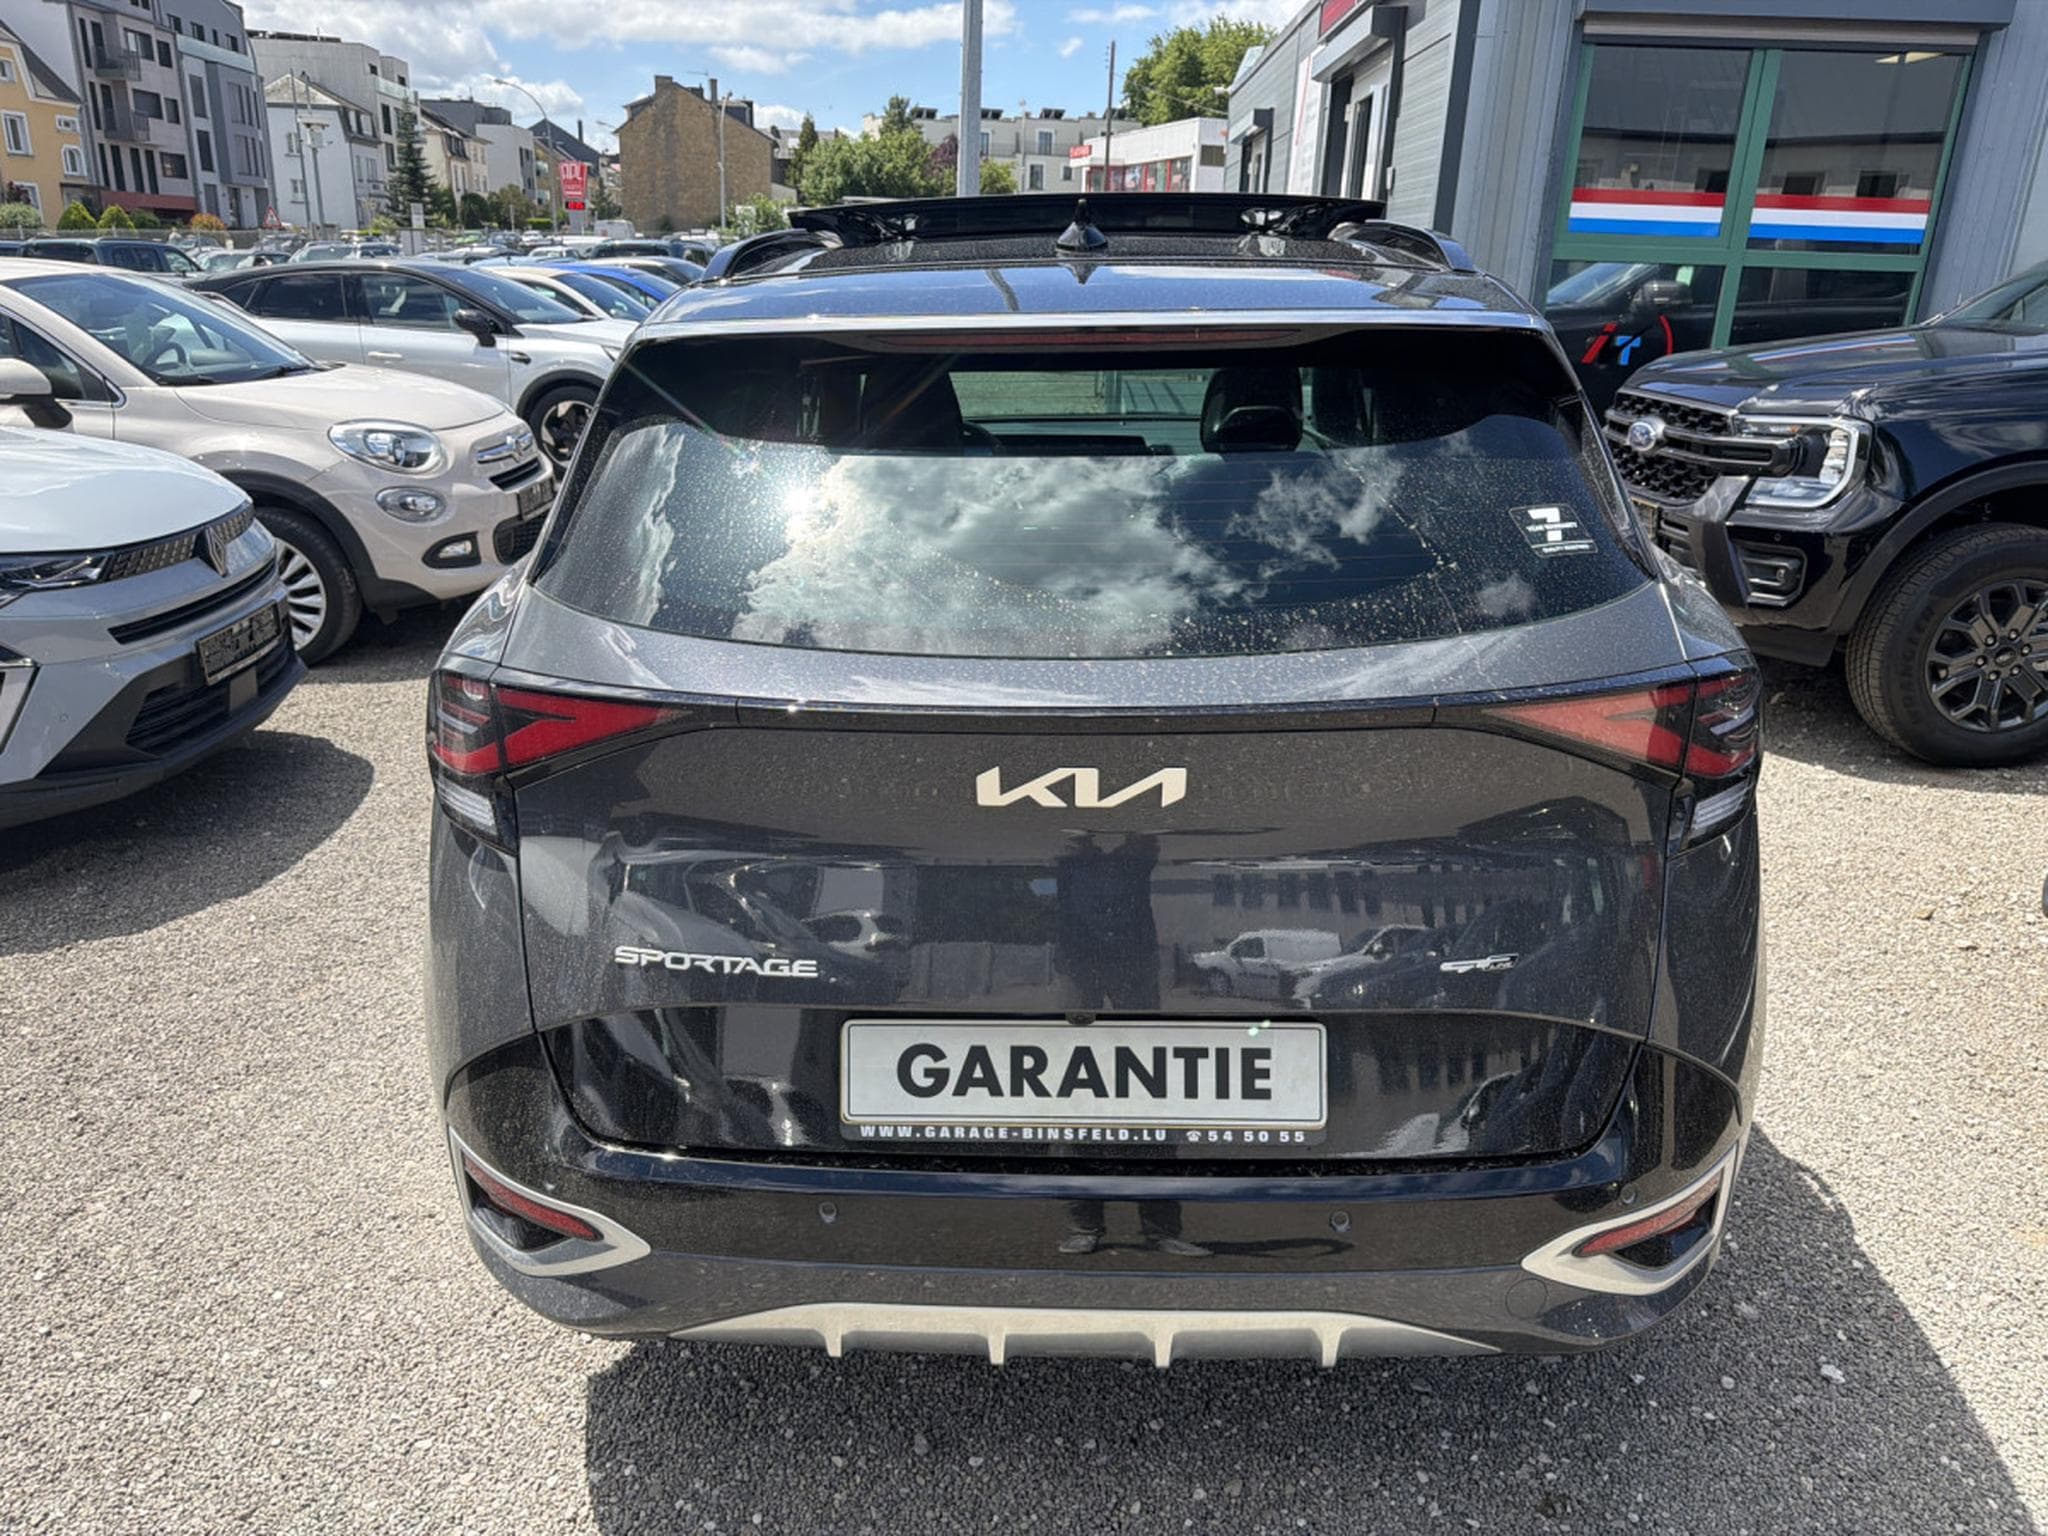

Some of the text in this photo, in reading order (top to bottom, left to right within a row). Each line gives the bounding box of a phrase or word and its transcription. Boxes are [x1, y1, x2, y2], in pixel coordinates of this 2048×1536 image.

[976, 766, 1187, 808] KIA
[614, 946, 818, 978] SPORTAGE
[896, 1043, 1272, 1100] GARANTIE
[860, 1125, 1305, 1143] WWW.GARAGE-BINSFELD.LU 54 50 55
